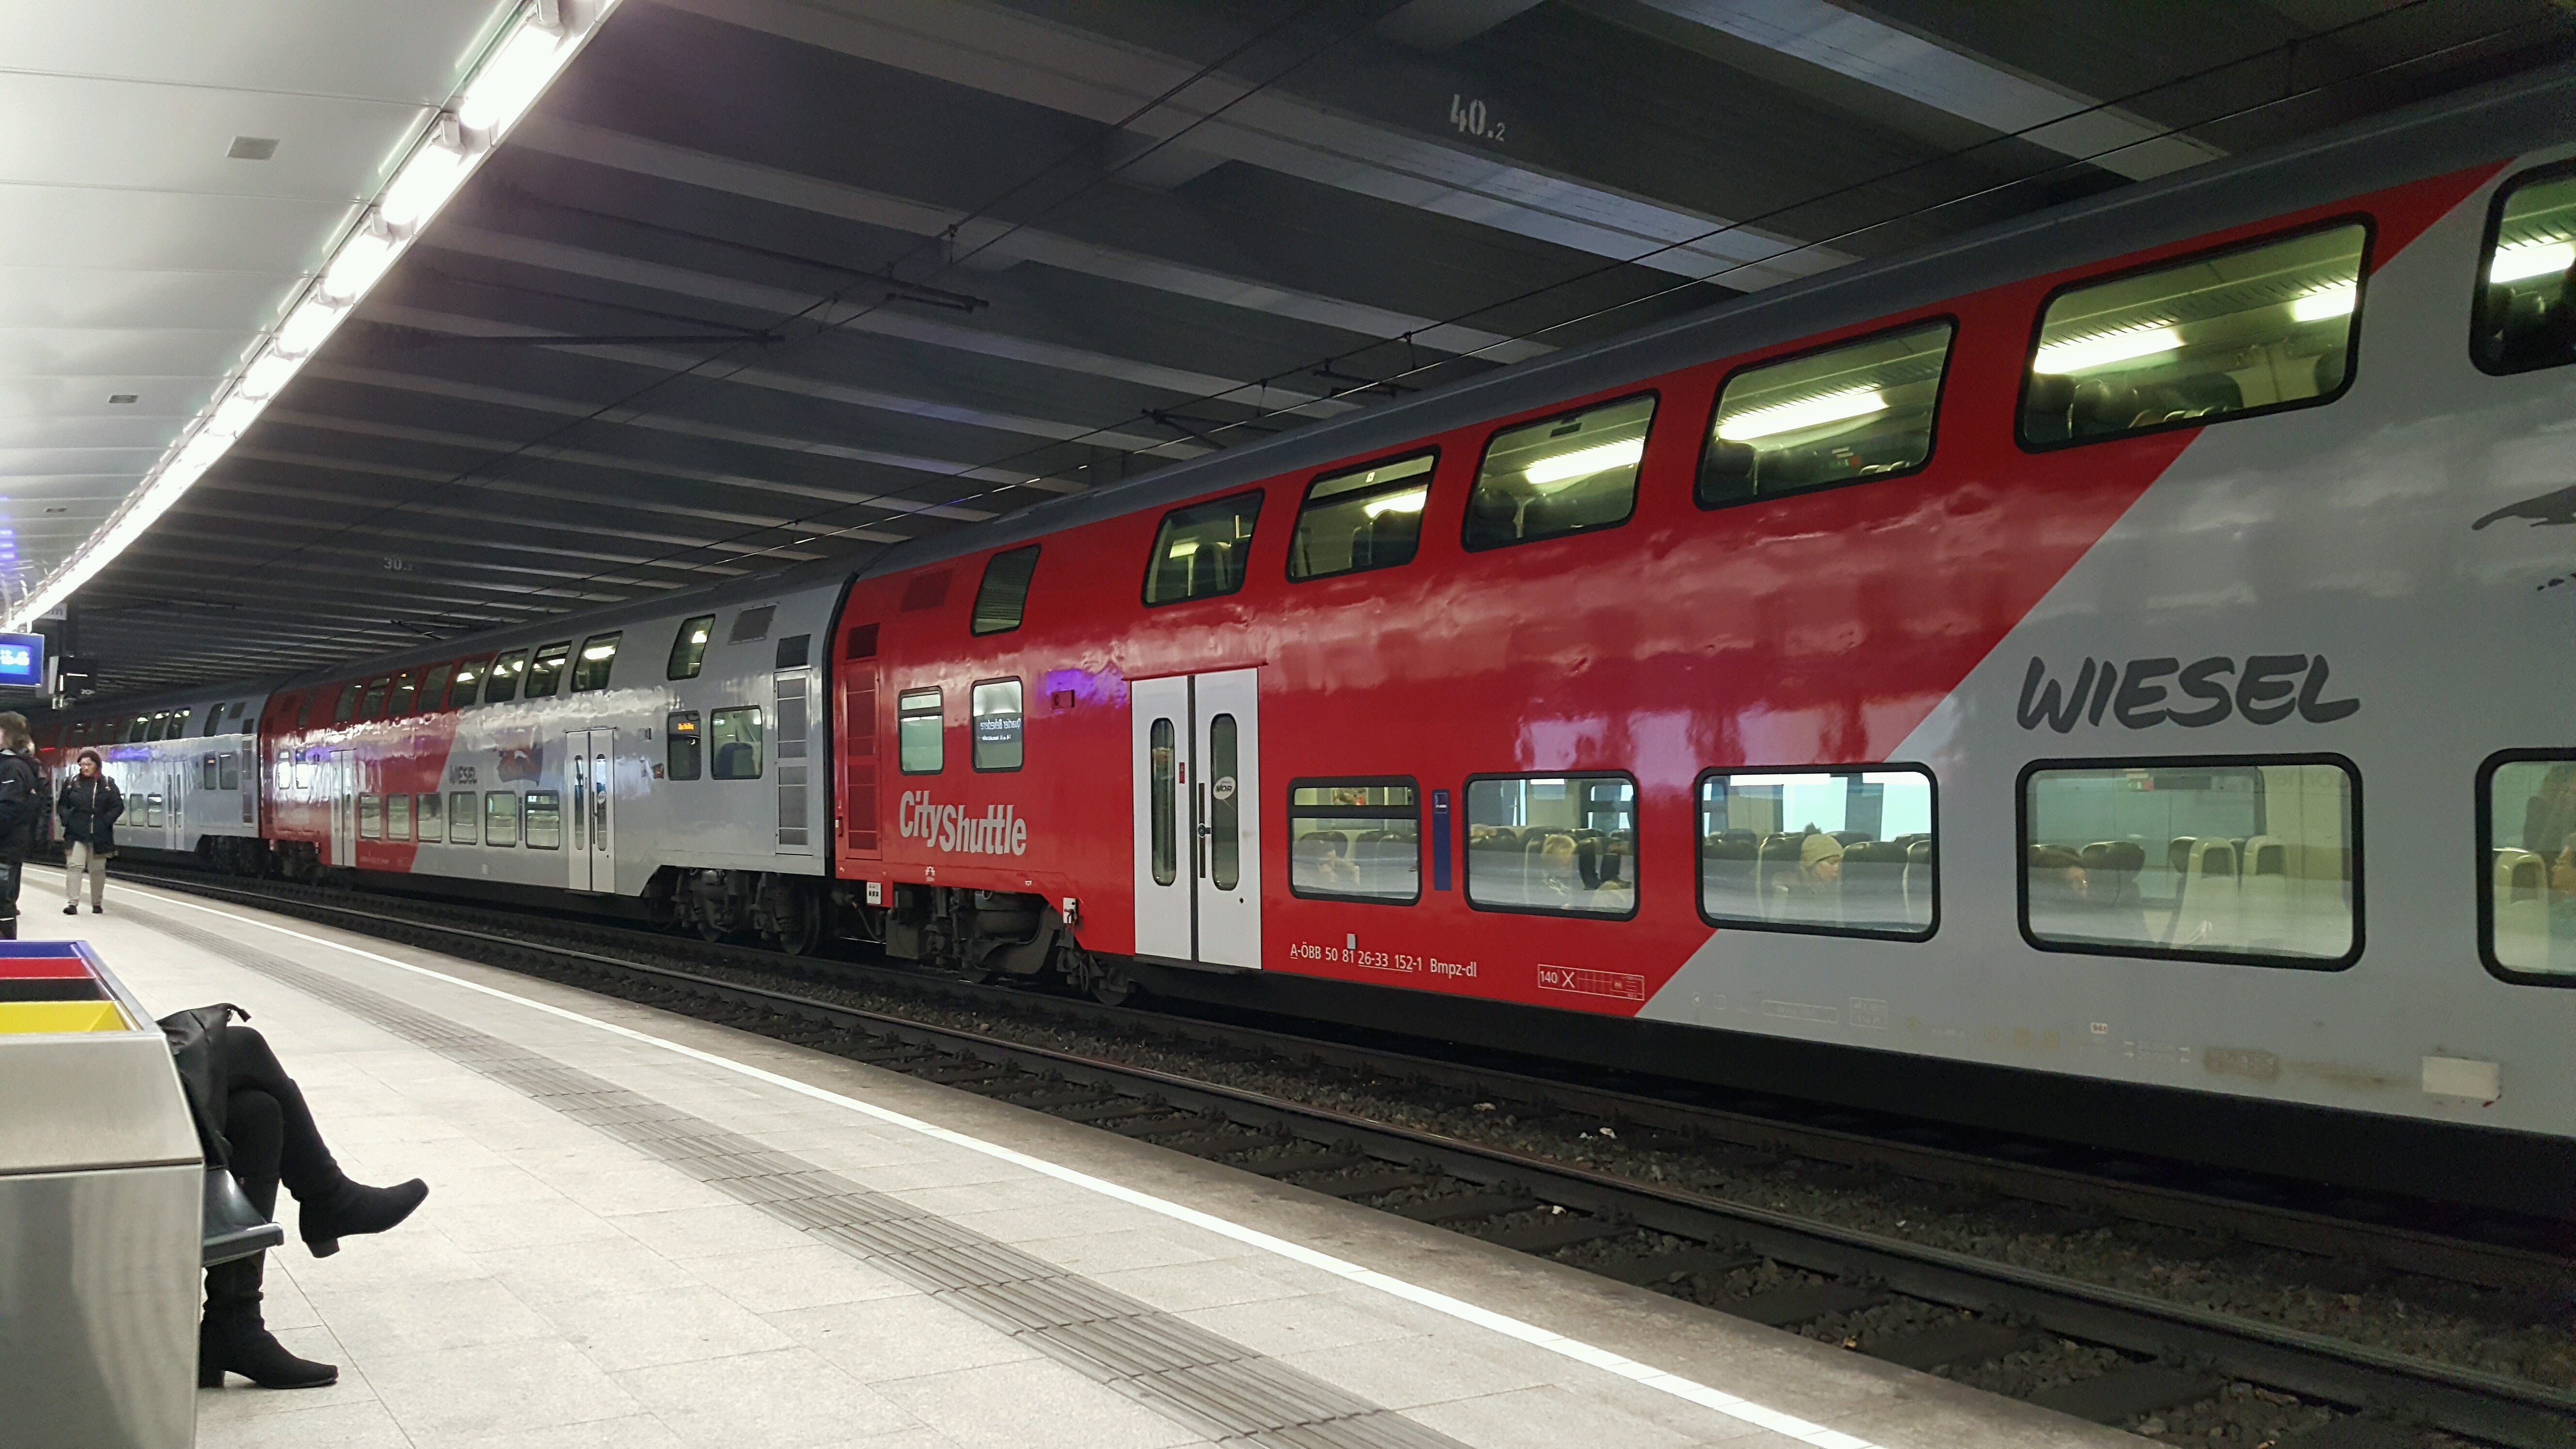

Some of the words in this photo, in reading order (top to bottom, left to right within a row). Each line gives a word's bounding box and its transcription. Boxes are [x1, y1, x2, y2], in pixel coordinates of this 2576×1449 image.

[1450, 94, 1505, 141] 40.2
[2016, 654, 2360, 734] WIESEL
[900, 790, 1027, 856] CityShuttle
[1290, 942, 1321, 959] A-ÖBB
[1325, 947, 1338, 961] 50
[1342, 949, 1354, 963] 81
[1358, 950, 1388, 967] 26-33
[1394, 954, 1422, 971] 152-1
[1431, 958, 1477, 979] Bmpz-dl
[1540, 971, 1558, 983] 140
